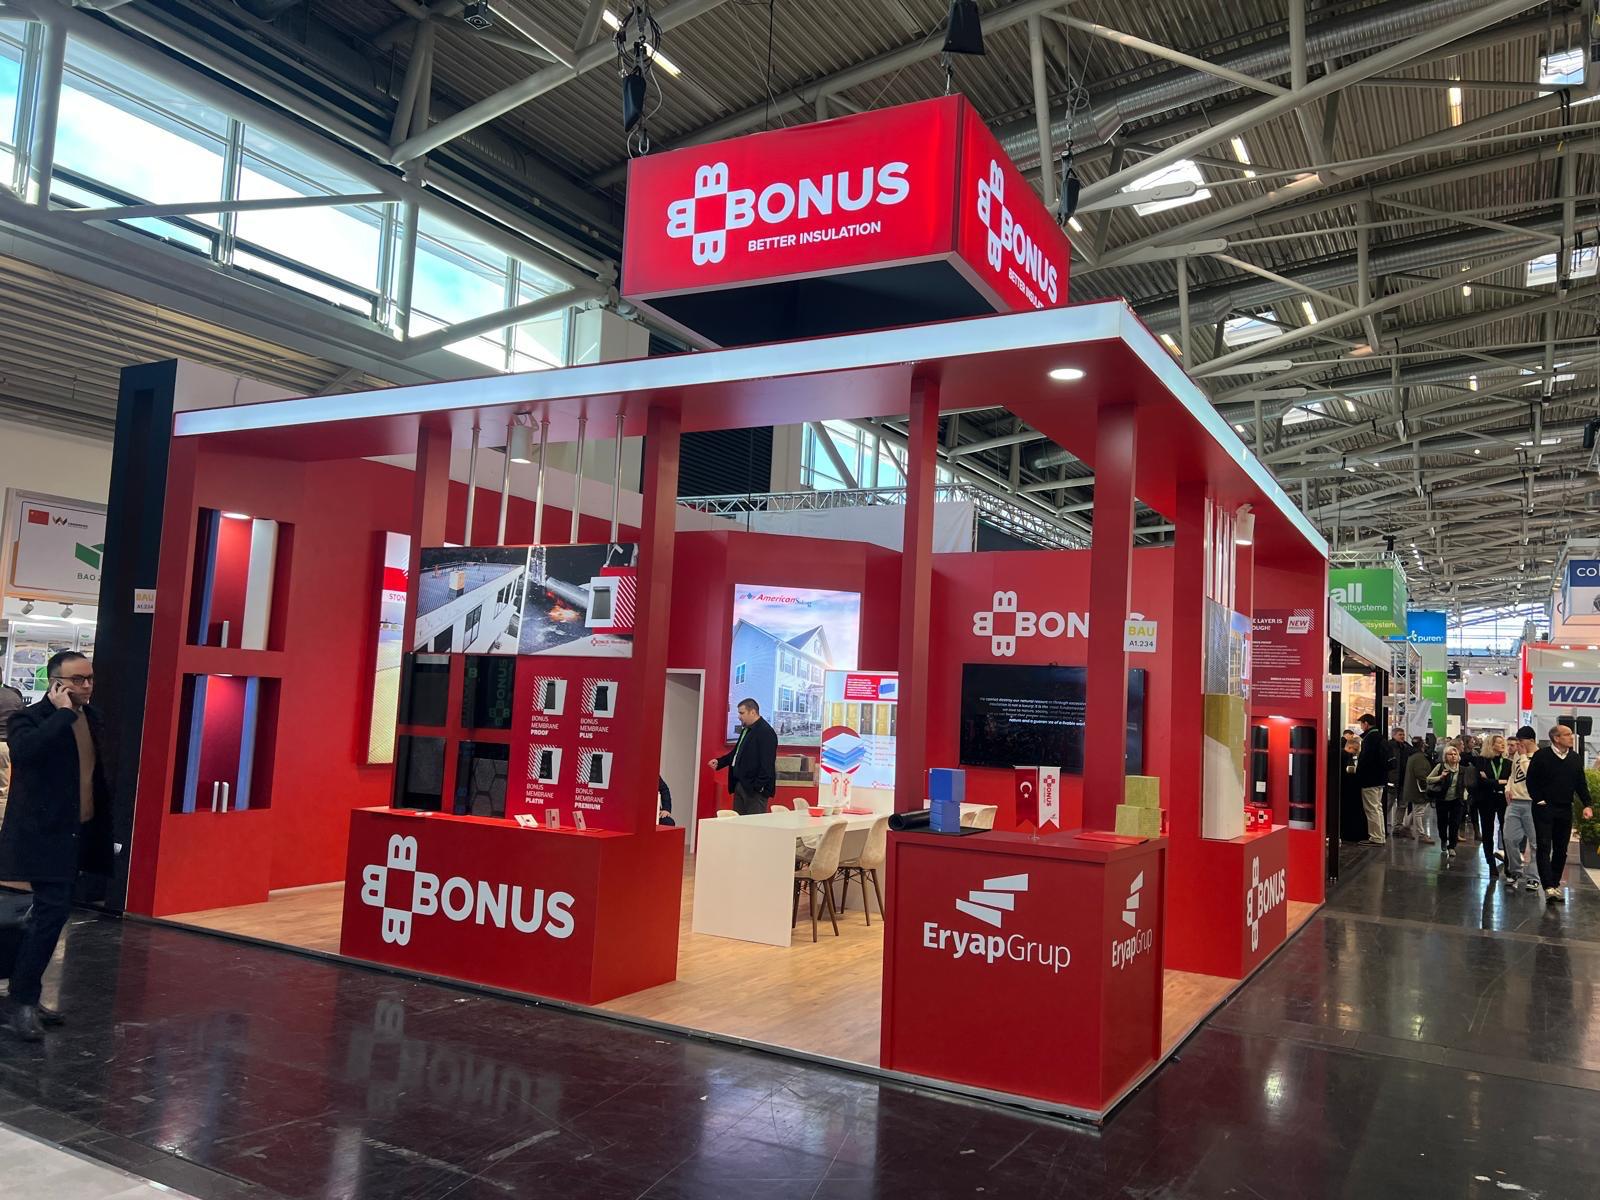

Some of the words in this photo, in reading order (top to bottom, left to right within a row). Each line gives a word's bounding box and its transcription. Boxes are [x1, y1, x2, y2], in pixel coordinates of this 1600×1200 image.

[727, 161, 910, 230] BONUS
[748, 234, 796, 252] BETTER
[800, 220, 881, 244] INSULATION
[1002, 204, 1057, 304] BONUS
[77, 573, 96, 581] BAO
[136, 592, 155, 602] BAU
[1342, 604, 1388, 613] eitsysteme
[1128, 626, 1155, 636] BAU
[1418, 635, 1442, 643] puren
[1129, 640, 1154, 648] A1.234
[1548, 685, 1600, 704] WOL
[531, 722, 559, 730] MEMBRANE
[580, 725, 609, 733] MEMBRANE
[526, 783, 544, 791] BONUS
[576, 787, 593, 795] BONUS
[526, 790, 554, 799] MEMBRANE
[525, 797, 544, 805] PLATIN
[575, 795, 604, 804] MEMBRANE
[574, 802, 601, 811] PREMIUM
[1257, 868, 1285, 919] BONUS
[412, 870, 575, 939] BONUS
[923, 921, 1071, 973] EryapGrup
[1111, 928, 1153, 971] EryapGrup
